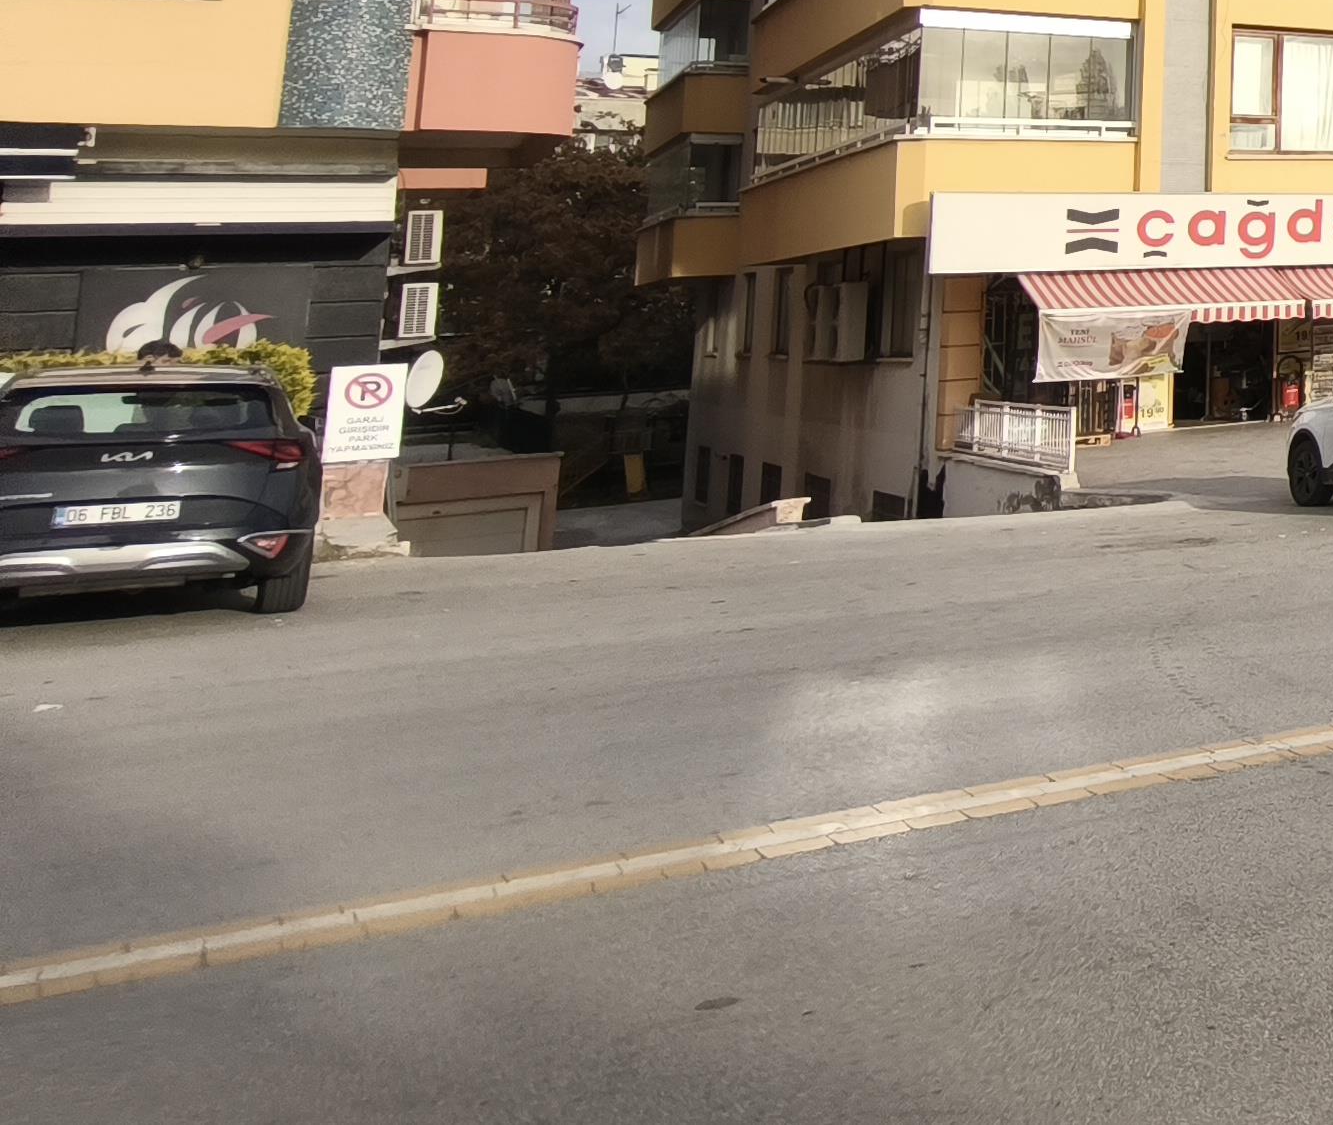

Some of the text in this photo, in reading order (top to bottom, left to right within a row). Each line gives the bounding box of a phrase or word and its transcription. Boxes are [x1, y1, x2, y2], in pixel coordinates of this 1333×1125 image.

[346, 416, 384, 425] GARAJ
[348, 434, 379, 442] PARK
[66, 503, 177, 523] 06 FBL 236
